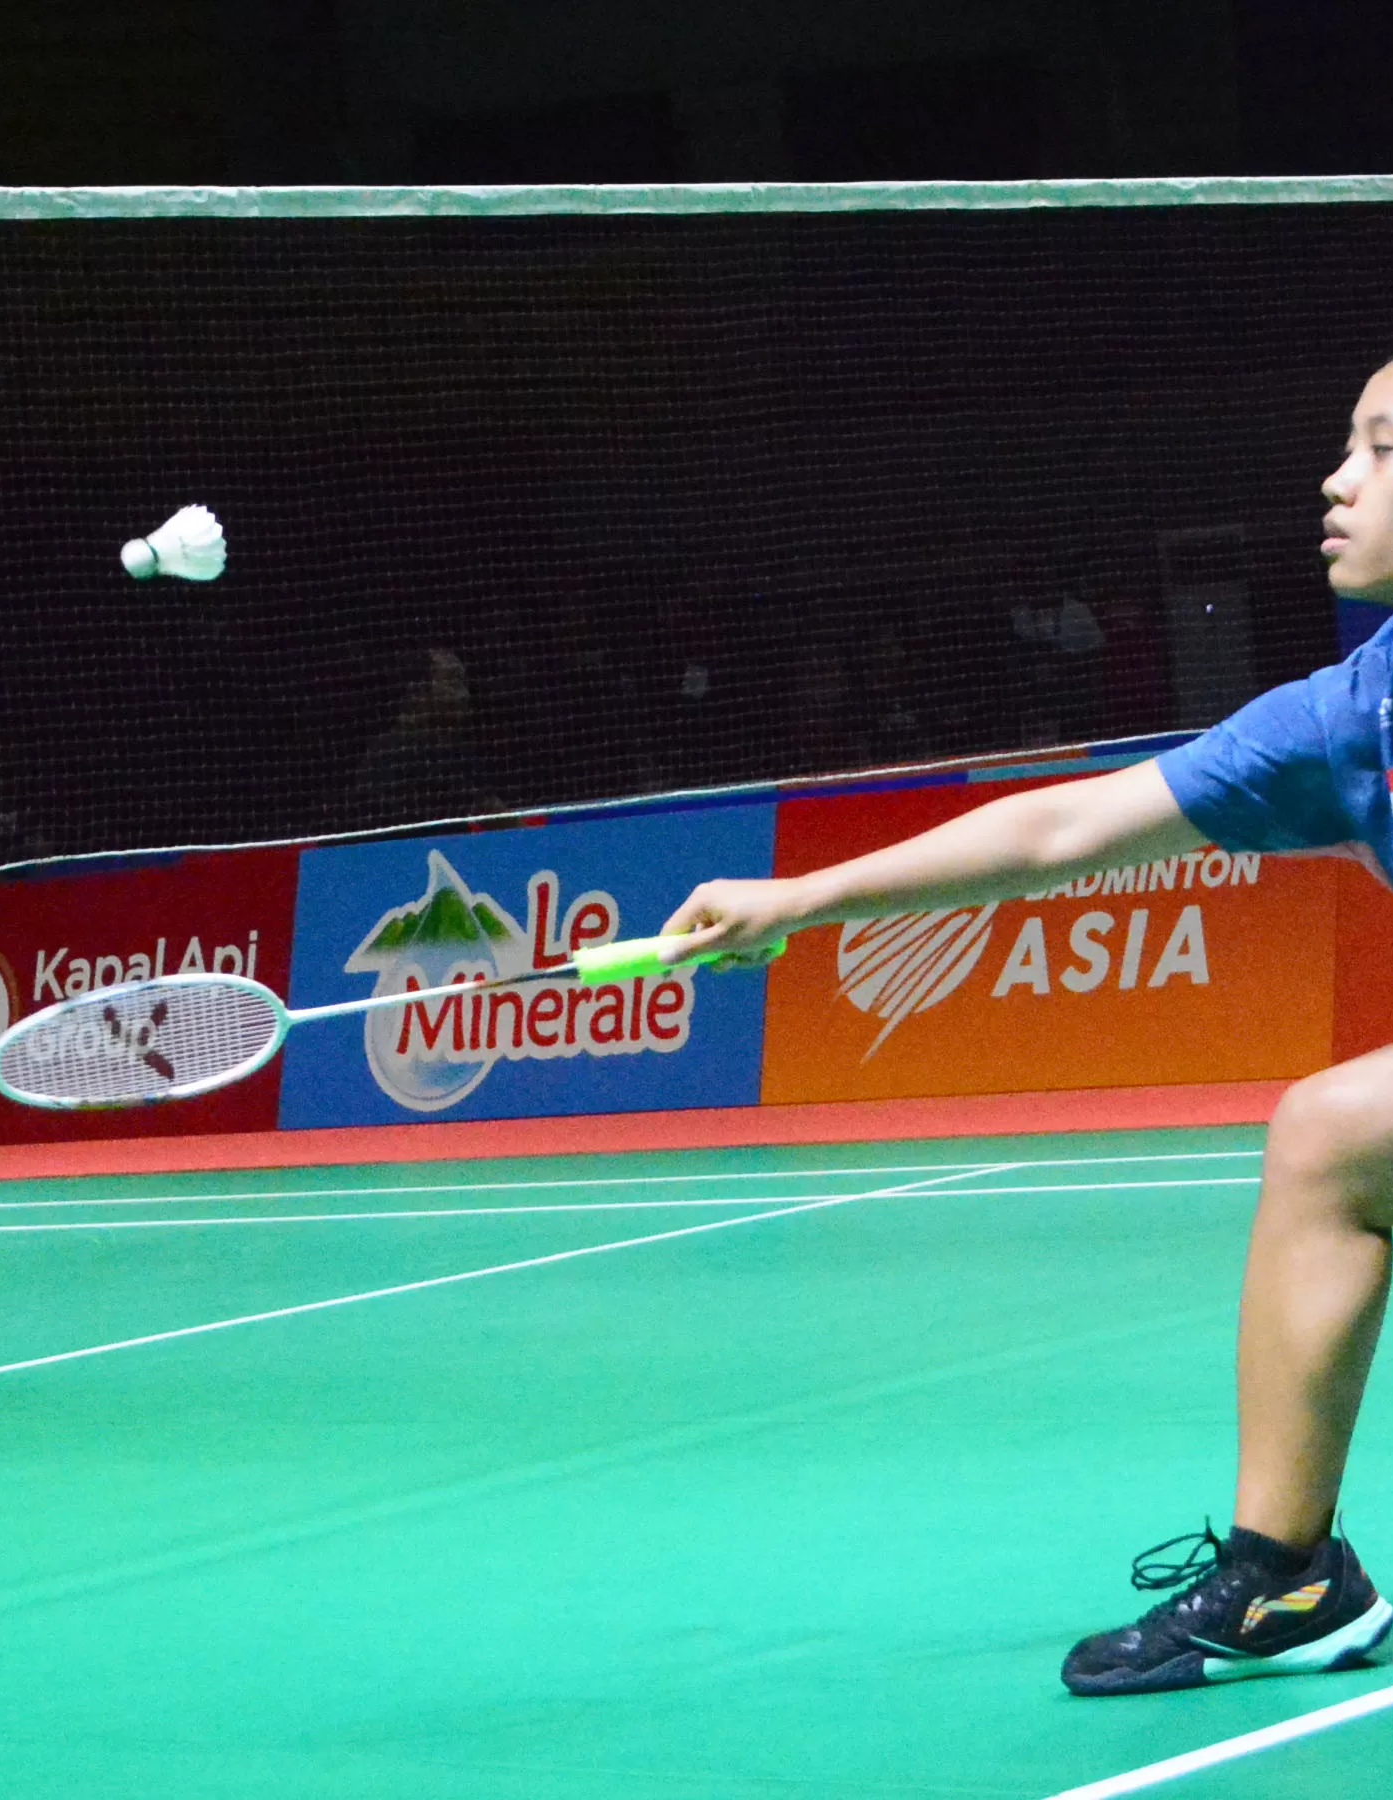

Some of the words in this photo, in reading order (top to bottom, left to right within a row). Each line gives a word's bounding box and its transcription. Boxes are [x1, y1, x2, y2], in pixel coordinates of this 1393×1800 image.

[1025, 850, 1262, 902] ADMINTON
[533, 882, 611, 970] Le
[991, 904, 1210, 998] ASIA
[33, 937, 167, 1001] Kapal
[396, 971, 686, 1055] Minerale
